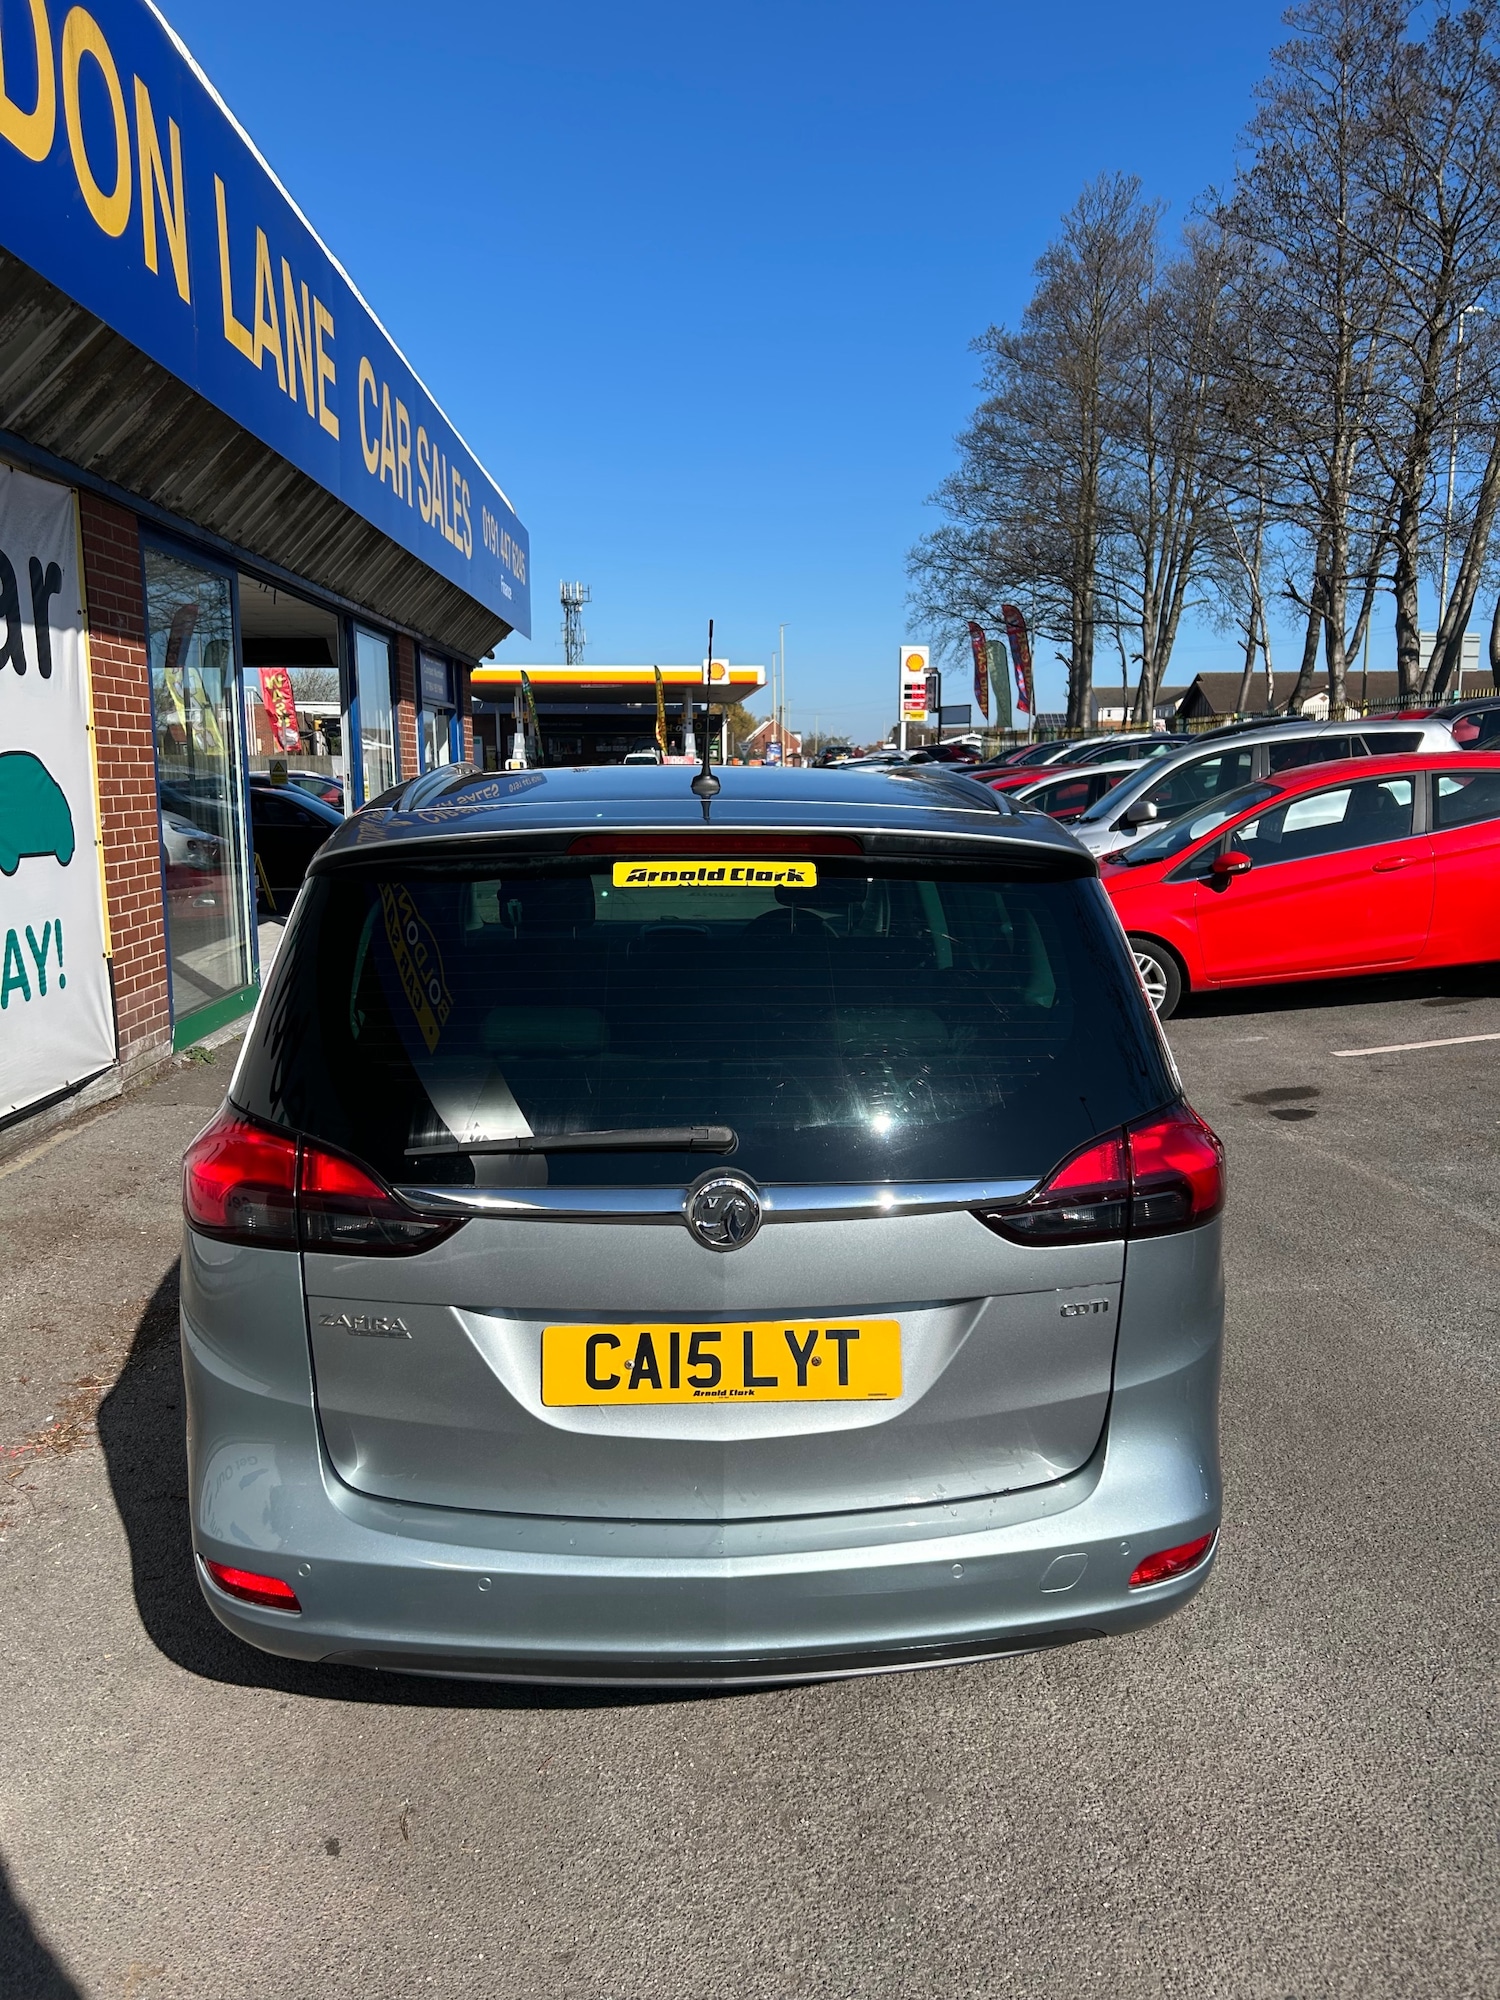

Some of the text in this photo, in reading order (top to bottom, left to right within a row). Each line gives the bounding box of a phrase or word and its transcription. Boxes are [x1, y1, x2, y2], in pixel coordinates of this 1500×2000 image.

[213, 172, 340, 441] LANE
[358, 355, 413, 508] CAR
[416, 425, 473, 561] SALES
[482, 504, 500, 559] 0191
[626, 867, 806, 882] Arnold Clark
[0, 918, 67, 1010] AY!
[319, 1314, 412, 1337] ZAFIRA
[586, 1329, 860, 1391] CA15 LYT
[693, 1389, 727, 1397] Arnold
